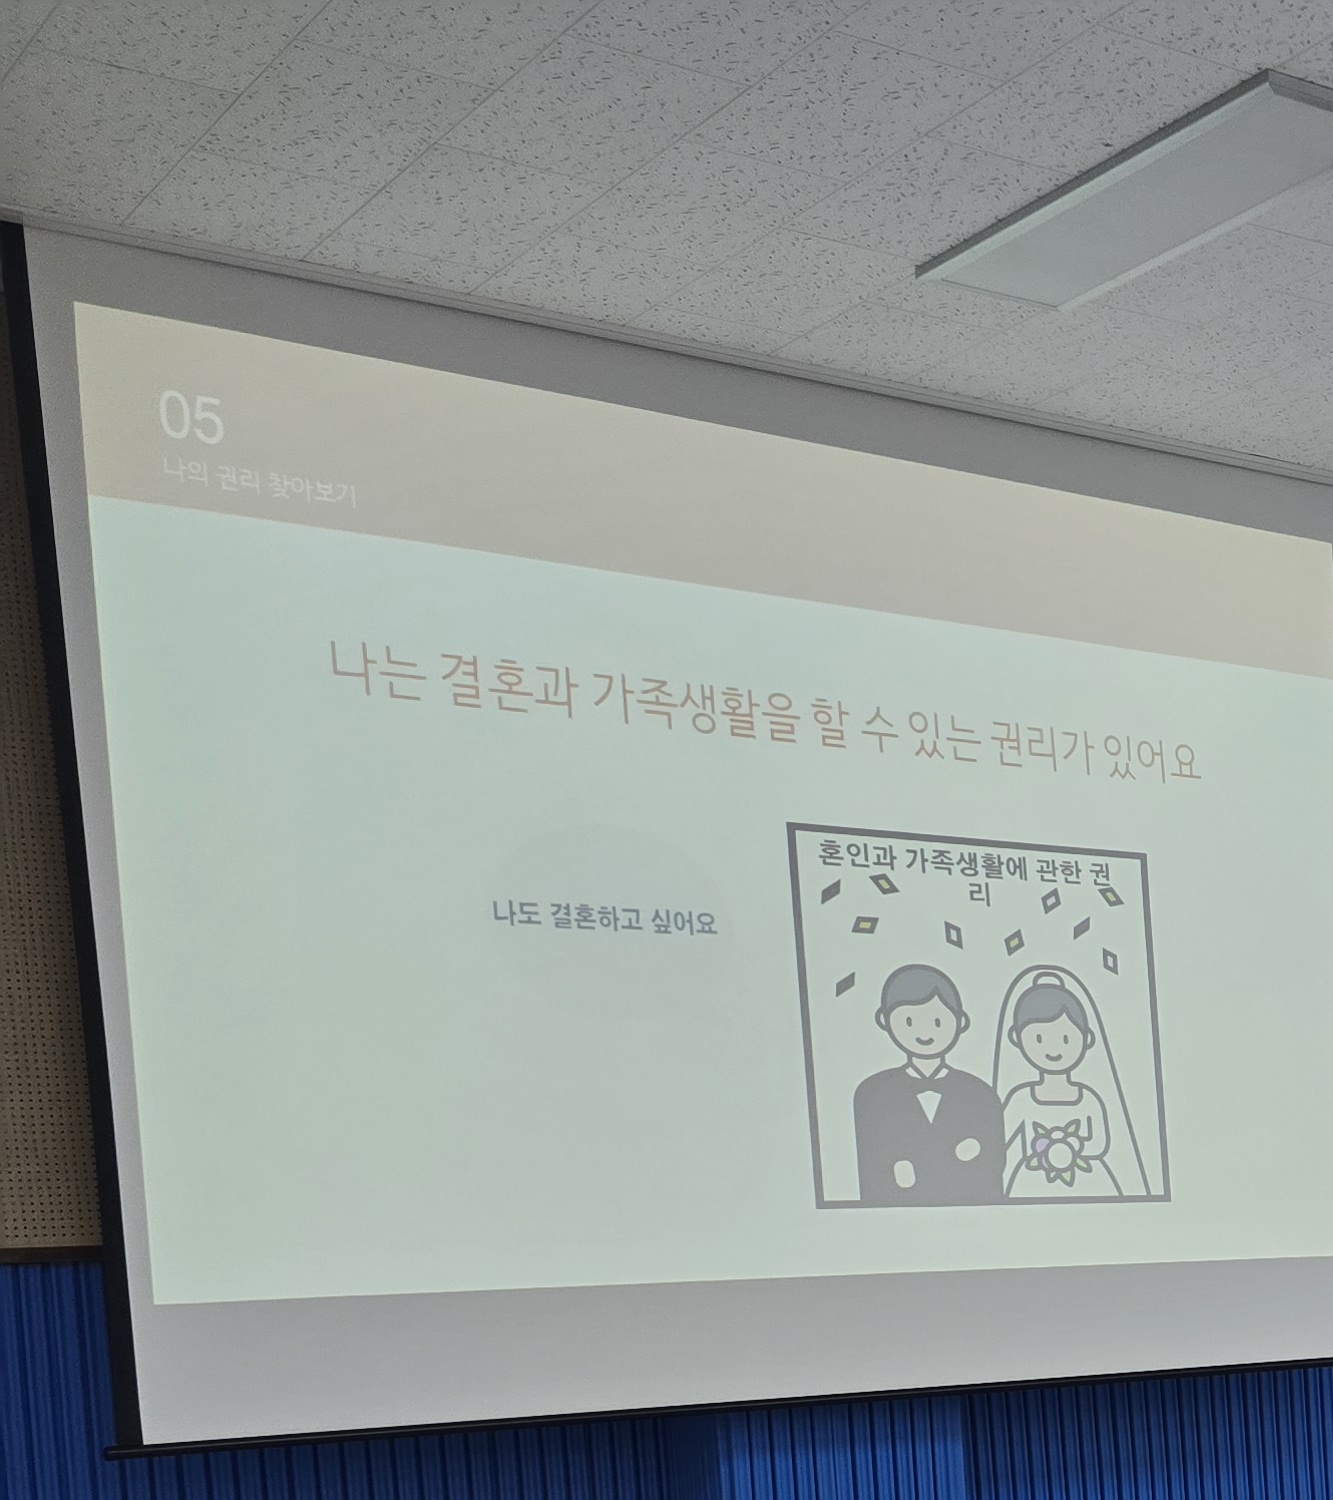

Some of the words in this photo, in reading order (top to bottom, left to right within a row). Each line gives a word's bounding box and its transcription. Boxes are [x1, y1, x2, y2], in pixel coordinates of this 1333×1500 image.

[160, 390, 225, 444] 05
[162, 457, 208, 485] 나의
[216, 466, 260, 493] 권리
[268, 473, 356, 508] 찾아보기
[329, 640, 427, 702] 나는
[440, 653, 580, 719] 결혼과
[592, 673, 801, 744] 가족생활을
[810, 697, 850, 750] 할
[861, 706, 899, 754] 수
[908, 711, 982, 763] 있는
[990, 720, 1095, 776] 권리가
[1103, 734, 1202, 784] 있어요
[818, 839, 897, 871] 혼인과
[905, 847, 1028, 881] 가족생활에
[1036, 859, 1082, 885] 관한
[1089, 863, 1111, 886] 권
[492, 899, 542, 927] 나도
[550, 902, 644, 932] 결혼하고
[650, 908, 718, 936] 싶어요
[969, 882, 991, 907] 리
